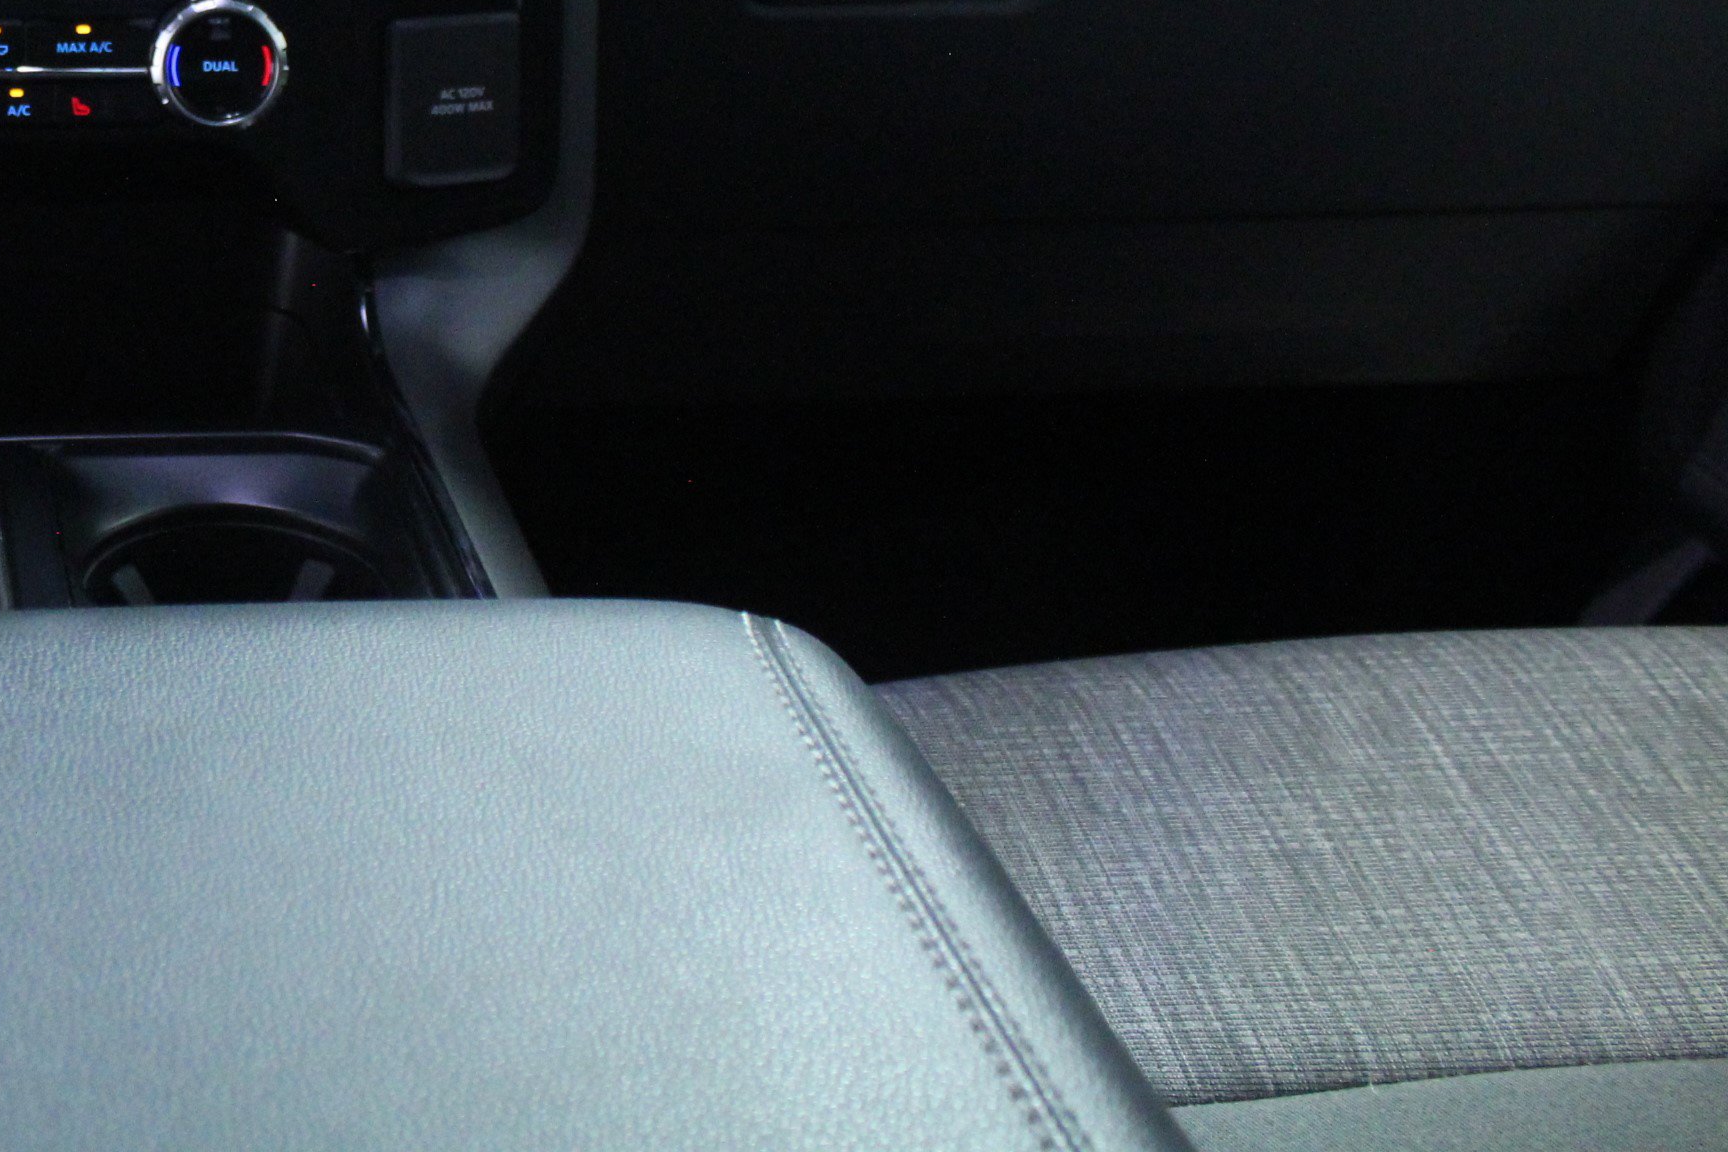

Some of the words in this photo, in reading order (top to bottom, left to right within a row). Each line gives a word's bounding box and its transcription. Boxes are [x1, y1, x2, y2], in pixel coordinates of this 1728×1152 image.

[56, 42, 86, 54] MAX
[89, 41, 113, 54] A/C
[202, 60, 239, 73] DUAL
[7, 104, 31, 117] A/C
